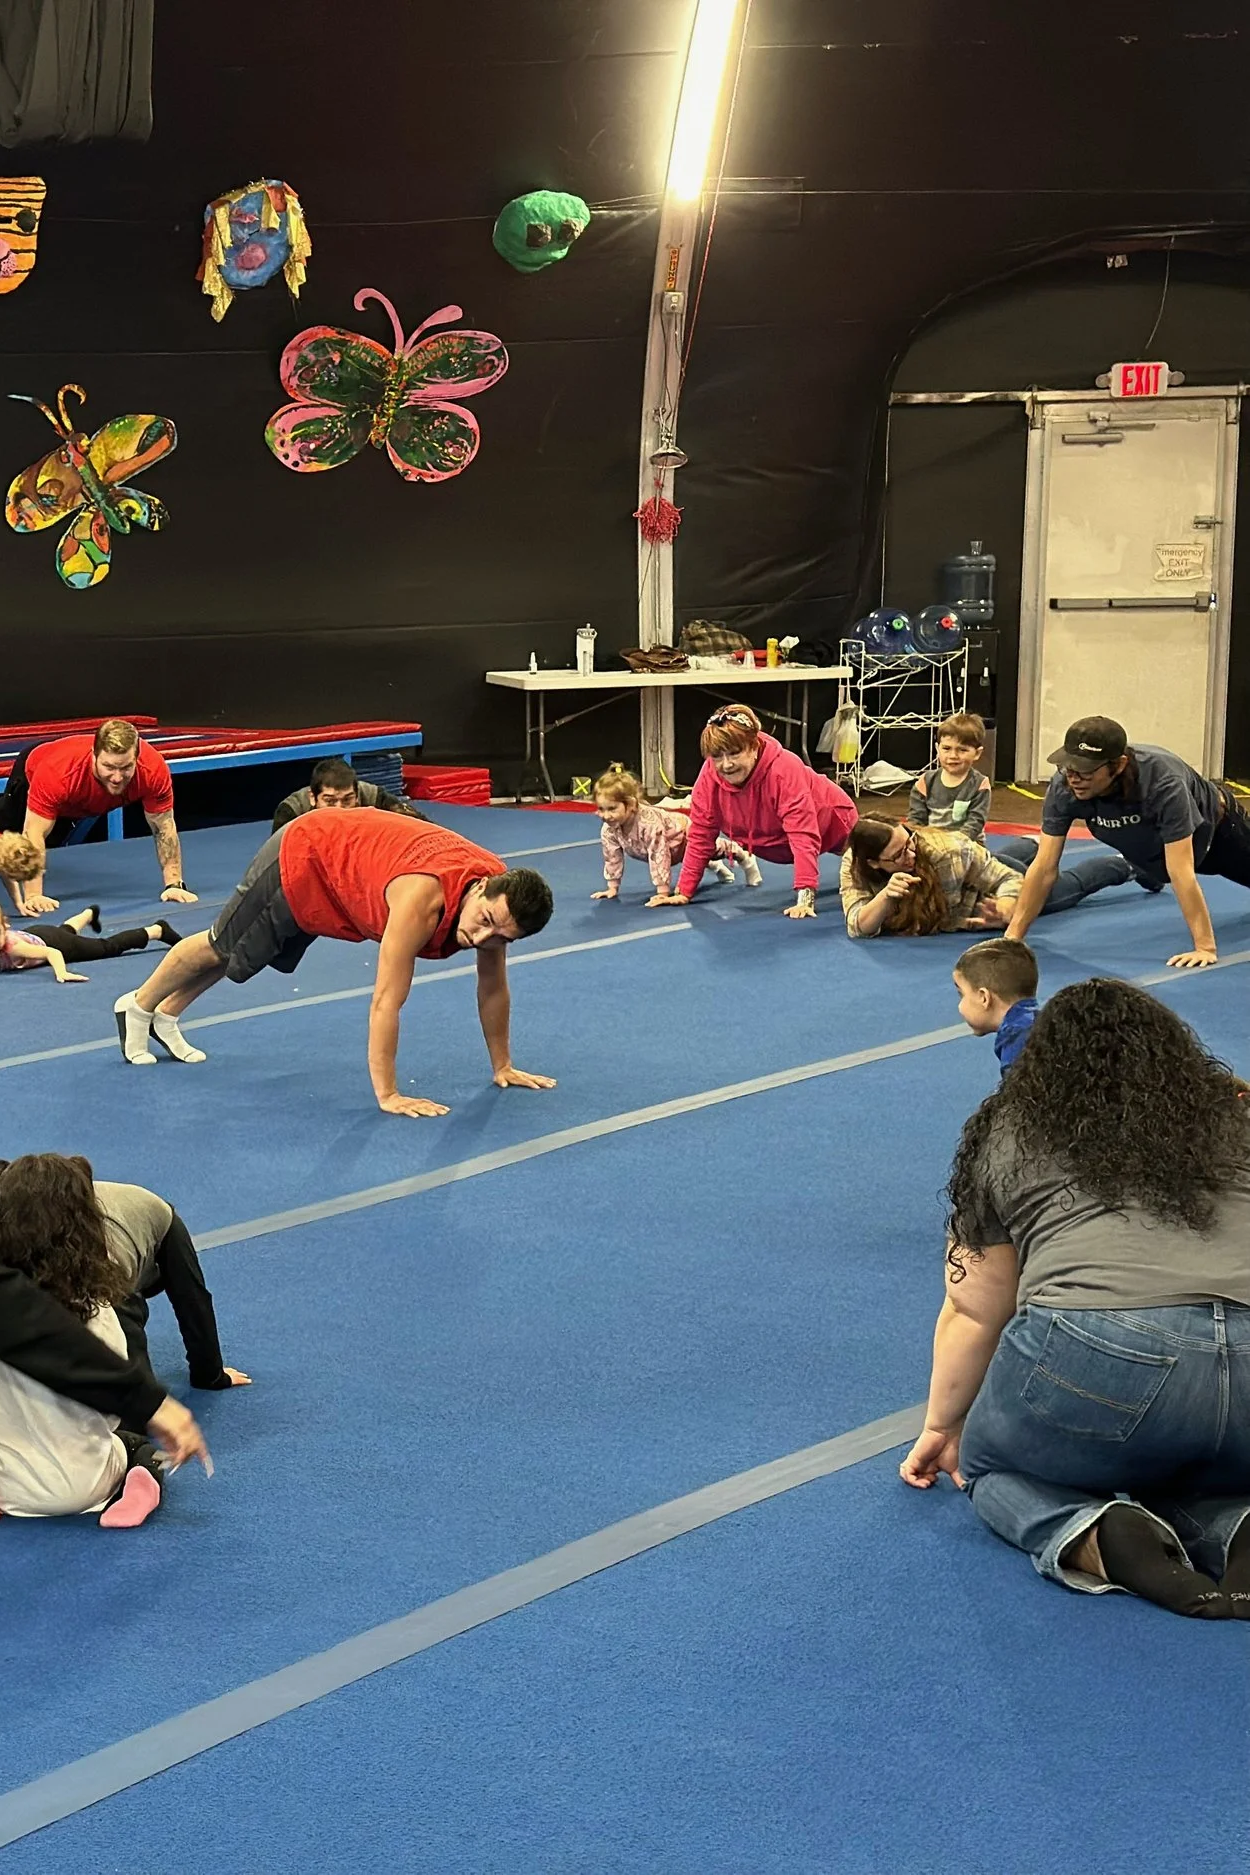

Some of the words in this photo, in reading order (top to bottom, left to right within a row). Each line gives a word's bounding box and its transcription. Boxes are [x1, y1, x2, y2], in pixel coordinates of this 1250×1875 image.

[1121, 365, 1162, 396] EXIT
[1168, 558, 1190, 567] EXIT
[1165, 568, 1191, 578] ONLY
